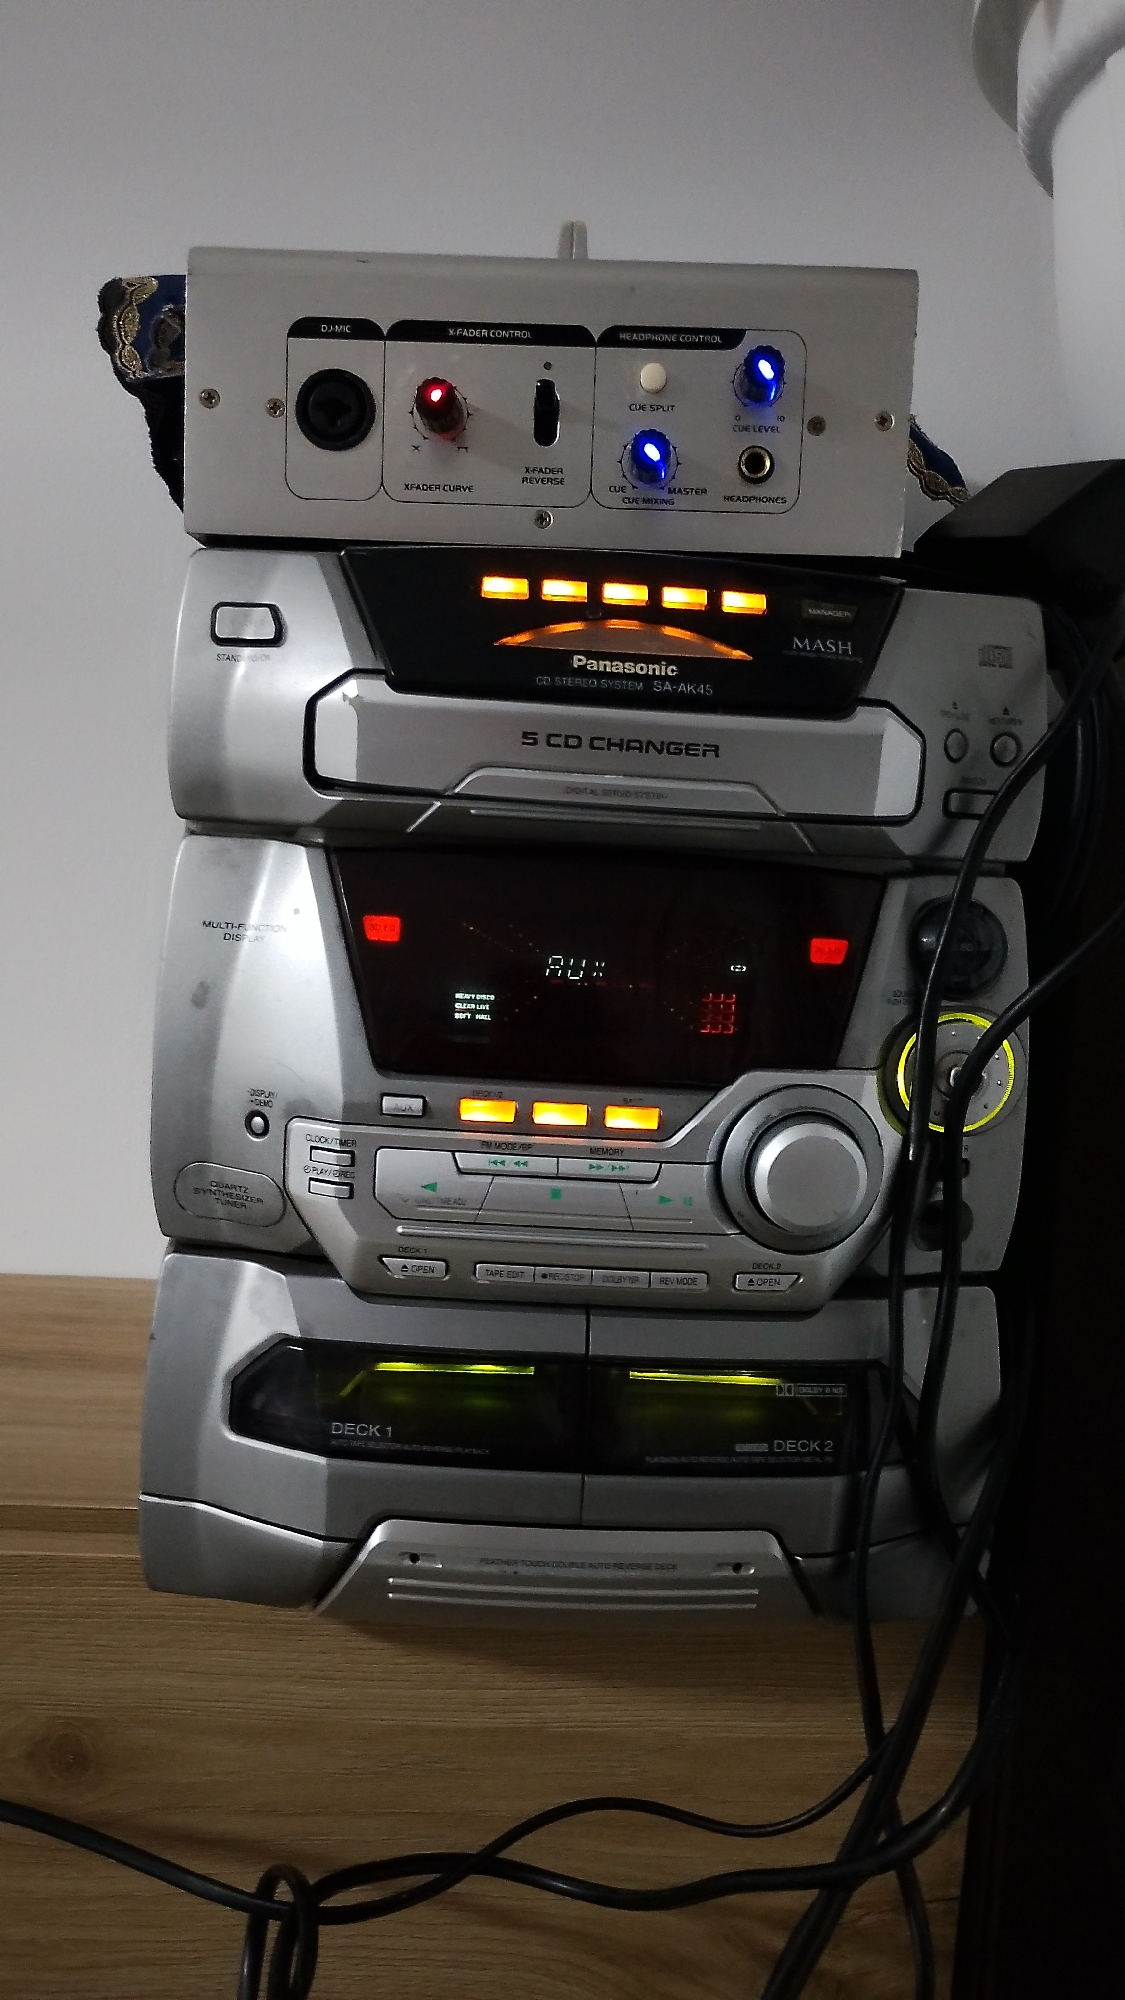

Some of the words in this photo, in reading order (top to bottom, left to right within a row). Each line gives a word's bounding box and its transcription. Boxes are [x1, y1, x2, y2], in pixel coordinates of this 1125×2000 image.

[448, 328, 488, 338] X-FADER
[490, 329, 533, 339] CONTROL
[619, 332, 678, 343] HEADPHONE
[679, 334, 723, 344] CONTROL
[629, 403, 647, 412] CUE
[649, 404, 675, 413] SPLIT
[732, 424, 751, 432] CUE
[753, 425, 781, 434] LEVEL
[525, 466, 564, 475] X-FADER
[522, 476, 566, 486] REVERSE
[443, 484, 474, 494] CURVE
[608, 484, 627, 494] CUE
[668, 486, 708, 496] MASTER
[622, 497, 641, 506] CUE
[643, 497, 675, 507] MIXING
[723, 494, 787, 505] HEADPHONES
[808, 608, 851, 618] MANAGER
[793, 636, 852, 655] MASH
[572, 655, 678, 676] Panasonic
[536, 676, 551, 686] CD
[554, 677, 597, 688] STEREO
[600, 679, 644, 691] SYSTEM
[653, 680, 714, 696] SA-AK45
[521, 731, 539, 746] 5
[545, 733, 583, 750] CD
[588, 736, 720, 758] CHANGER
[546, 955, 605, 980] AUX
[475, 1013, 492, 1021] HALL
[589, 1147, 624, 1157] MEMORY
[210, 1180, 249, 1194] QUARTZ
[193, 1186, 264, 1204] SYNTHESIZER
[214, 1197, 247, 1210] TUNER
[411, 1264, 435, 1274] OPEN
[752, 1262, 774, 1270] DECK
[485, 1268, 505, 1279] TAPE
[507, 1271, 524, 1279] EDIT
[659, 1276, 675, 1286] REV
[676, 1276, 698, 1286] MODE
[757, 1277, 781, 1287] OPEN
[331, 1422, 380, 1437] DECK
[385, 1426, 393, 1438] 1
[774, 1440, 821, 1452] DECK
[824, 1440, 834, 1452] 2
